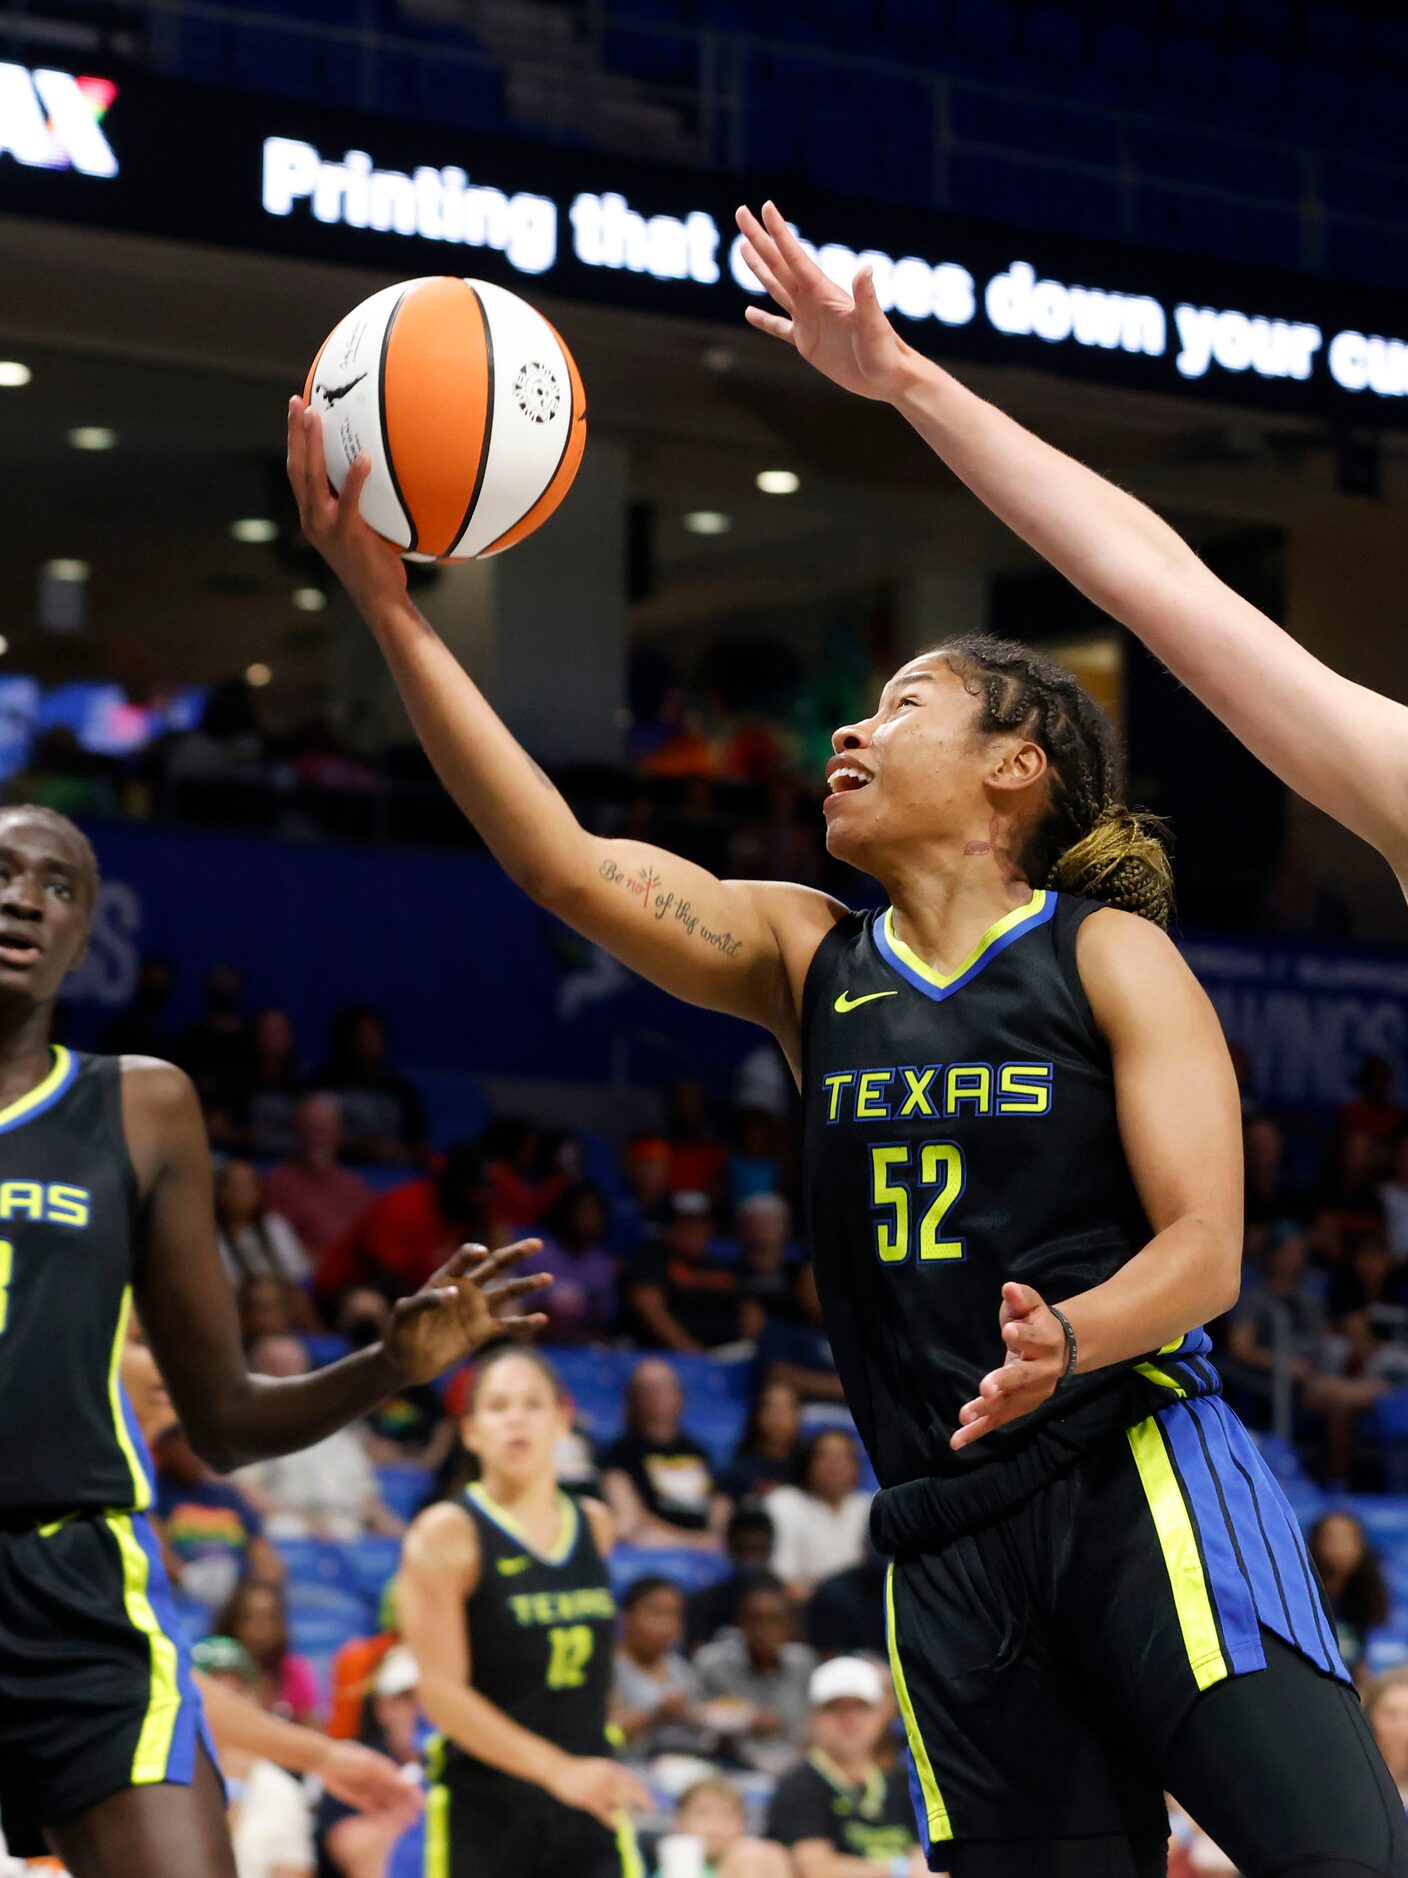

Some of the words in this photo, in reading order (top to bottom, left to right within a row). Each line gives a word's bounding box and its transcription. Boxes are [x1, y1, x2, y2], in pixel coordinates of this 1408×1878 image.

[262, 135, 557, 275] Printing
[569, 191, 720, 284] that
[985, 261, 1166, 357] down
[1174, 302, 1322, 379] your
[599, 859, 624, 883] Be
[655, 893, 674, 920] of
[674, 898, 700, 936] this
[700, 926, 743, 958] world
[822, 1061, 1054, 1125] TEXAS
[867, 1139, 968, 1265] 52
